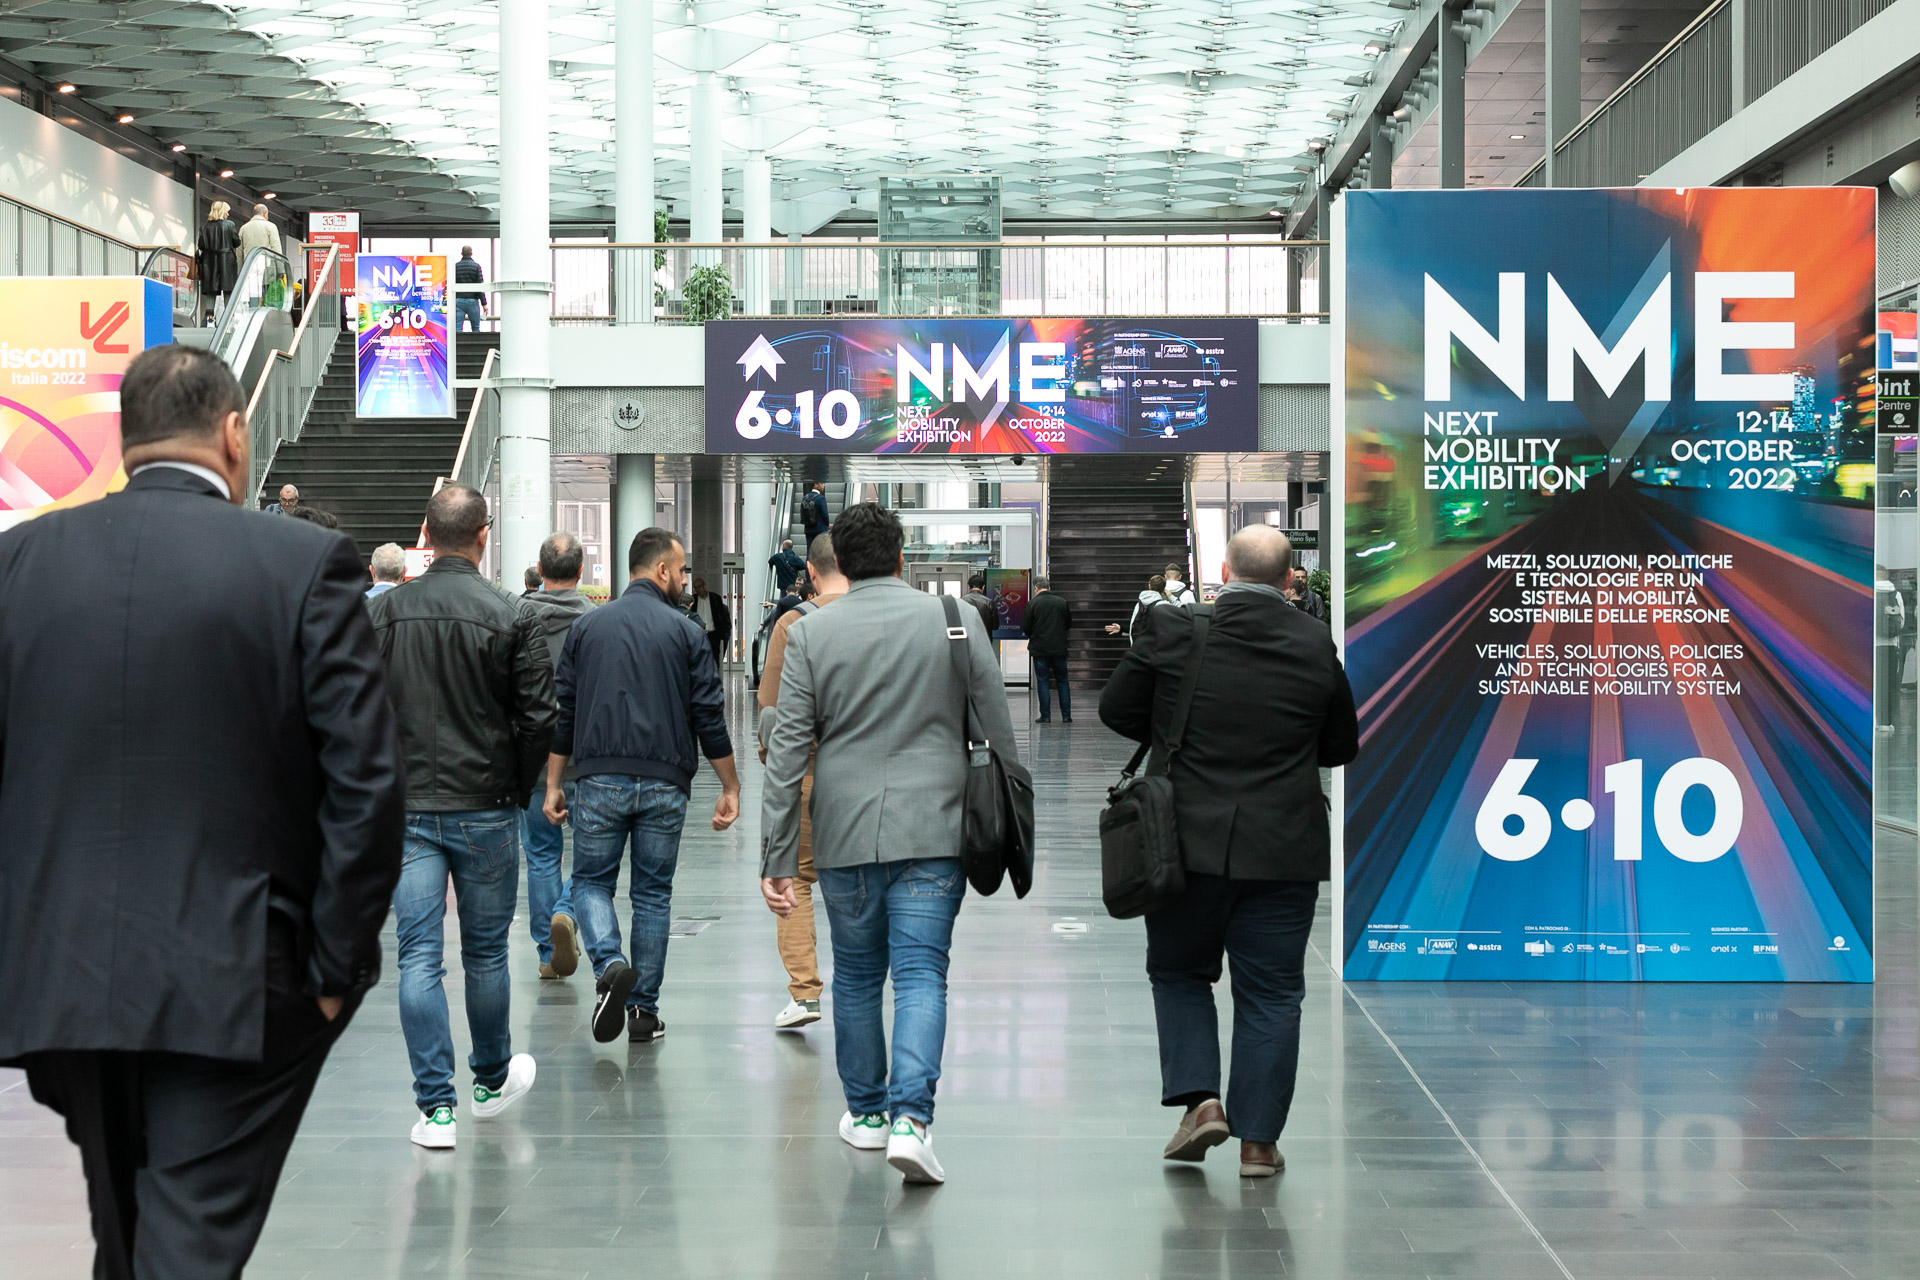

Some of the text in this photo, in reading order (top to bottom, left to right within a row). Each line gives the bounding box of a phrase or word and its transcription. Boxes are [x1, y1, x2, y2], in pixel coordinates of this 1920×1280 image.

[373, 266, 433, 288] NME
[379, 309, 427, 329] 6·10
[1424, 271, 1795, 402] NME
[0, 342, 86, 368] iscom
[1123, 347, 1146, 355] AGENS
[11, 371, 86, 385] Italia 2022
[897, 342, 1066, 403] NME
[897, 406, 931, 418] NEXT
[1038, 405, 1066, 417] 12·14
[1878, 400, 1911, 410] Centre
[735, 389, 861, 440] 6·10
[1736, 410, 1794, 433] 12·14
[897, 418, 960, 430] MOBILITY
[1008, 418, 1065, 430] OCTOBER
[1424, 411, 1499, 436] NEXT
[897, 430, 971, 443] EXHIBITION
[1034, 431, 1066, 443] 2022
[1424, 438, 1561, 463] MOBILITY
[1671, 439, 1795, 462] OCTOBER
[1424, 465, 1586, 491] EXHIBITION
[1728, 467, 1795, 490] 2022
[424, 555, 435, 567] 3
[1486, 554, 1733, 572] MEZZI, SOLUZIONI, POLITICHE
[1515, 572, 1704, 588] E TECNOLOGIE PER UN
[1521, 587, 1698, 606] SISTEMA DI MOBILITÀ
[1489, 608, 1730, 624] SOSTENIBILE DELLE PERSONE
[1475, 644, 1744, 662] VEHICLES, SOLUTIONS, POLICIES
[1494, 662, 1725, 678] AND TECHNOLOGIES FOR A
[1478, 680, 1741, 696] SUSTAINABLE MOBILITY SYSTEM
[1475, 757, 1744, 863] 6·10
[1378, 942, 1406, 950] AGENS
[1431, 941, 1454, 949] ANAV
[1478, 943, 1502, 951] asstra
